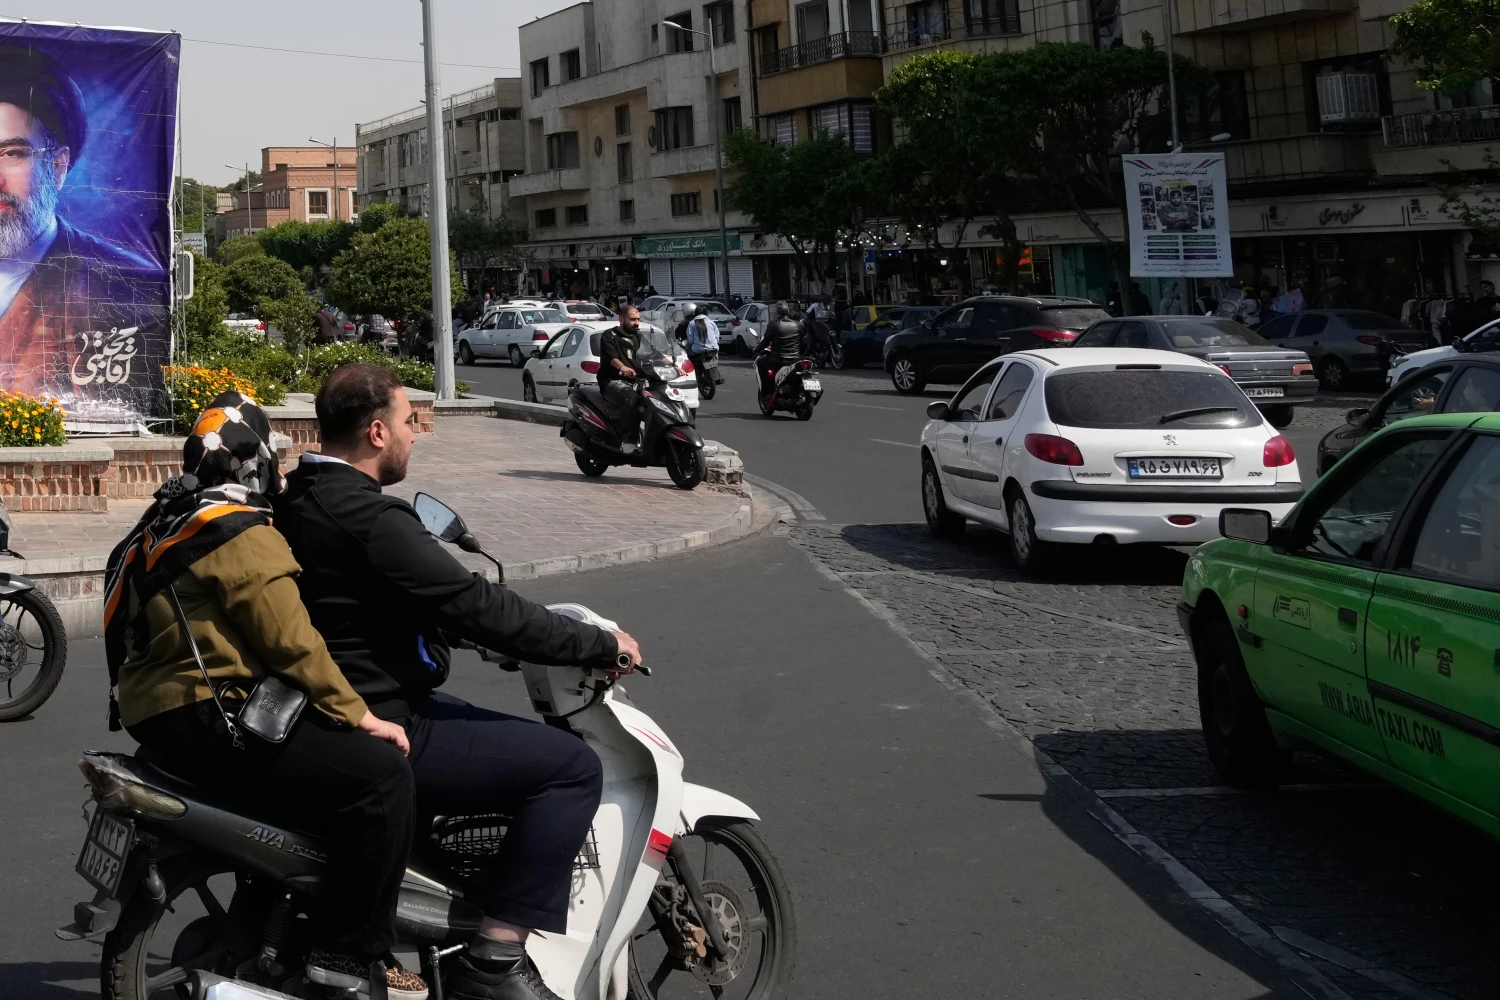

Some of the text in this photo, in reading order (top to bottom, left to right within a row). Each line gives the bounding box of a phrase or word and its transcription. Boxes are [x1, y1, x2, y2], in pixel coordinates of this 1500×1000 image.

[656, 239, 707, 252] بانک کشاورزی
[1138, 460, 1157, 474] ۹۵
[1173, 460, 1200, 474] ۷۸۹
[245, 826, 286, 849] AVA
